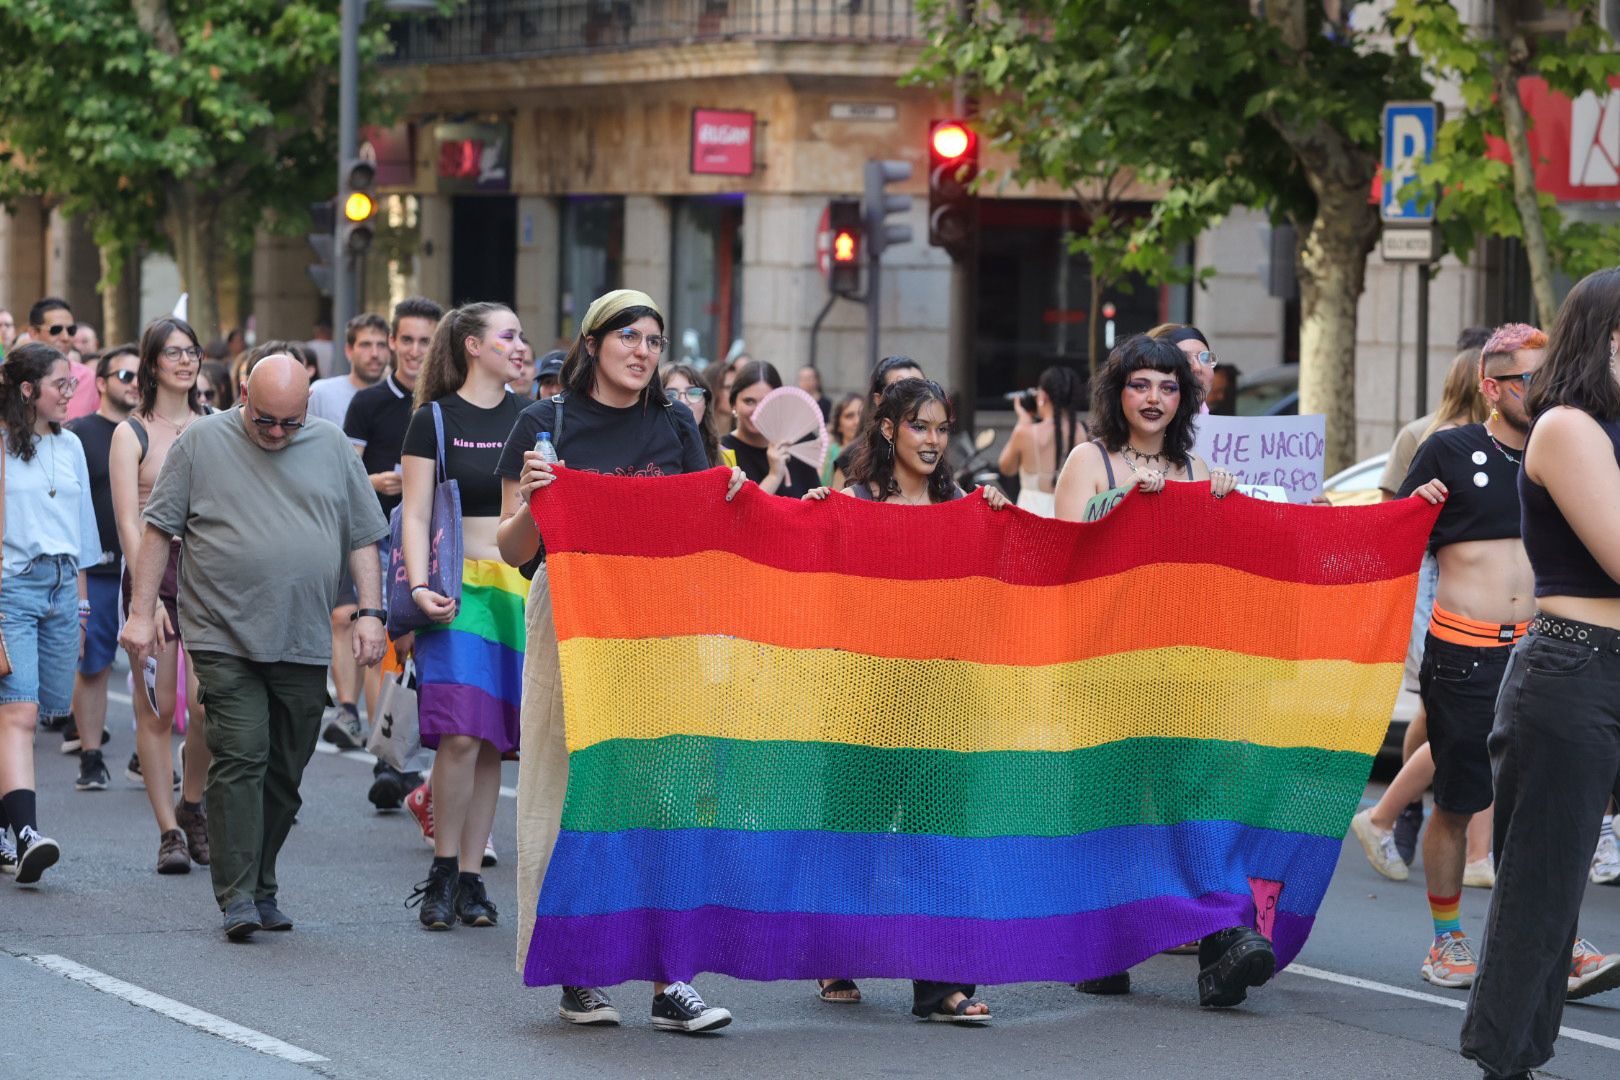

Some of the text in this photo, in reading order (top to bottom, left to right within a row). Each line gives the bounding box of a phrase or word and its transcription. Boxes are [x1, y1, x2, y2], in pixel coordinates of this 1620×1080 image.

[1386, 114, 1426, 214] P
[453, 438, 475, 448] kiss
[1212, 433, 1250, 464] HE
